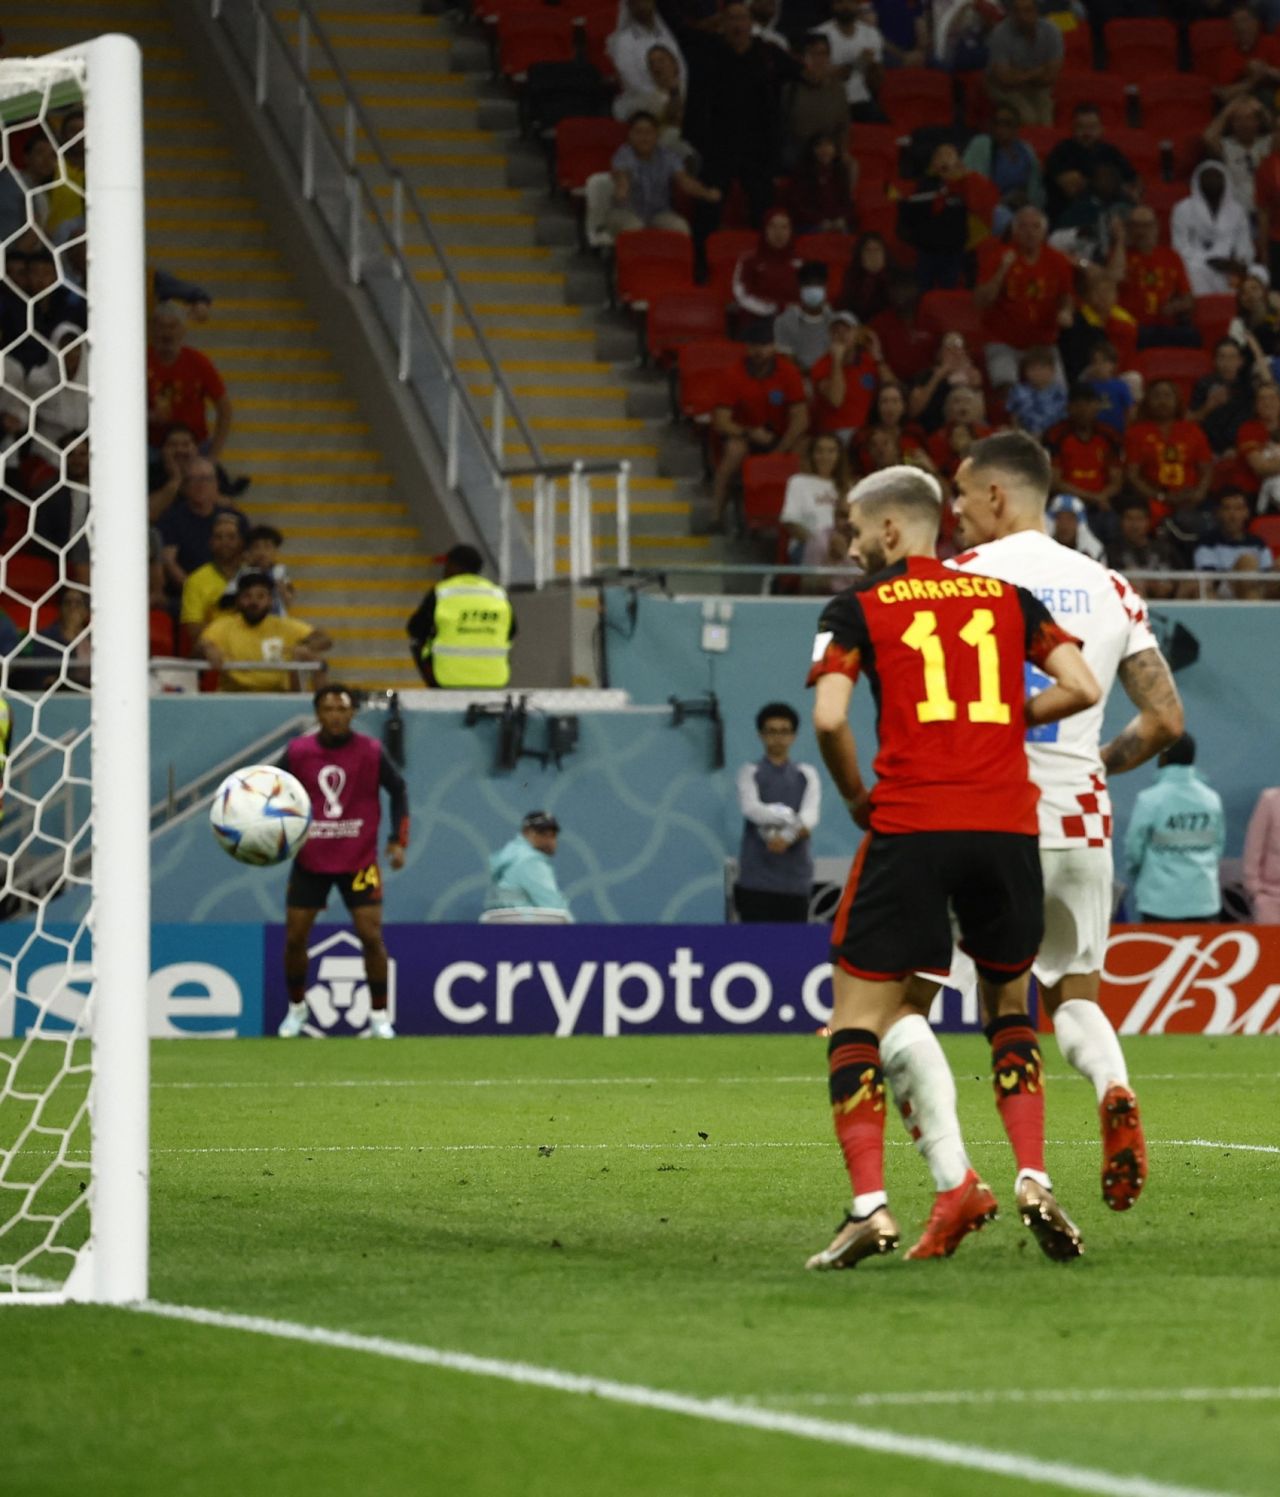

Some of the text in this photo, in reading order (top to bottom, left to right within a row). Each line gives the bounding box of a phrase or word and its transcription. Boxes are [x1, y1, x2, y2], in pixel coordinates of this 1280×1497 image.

[877, 576, 1004, 604] CARRASCO
[901, 608, 1011, 725] 11
[352, 864, 379, 892] 24
